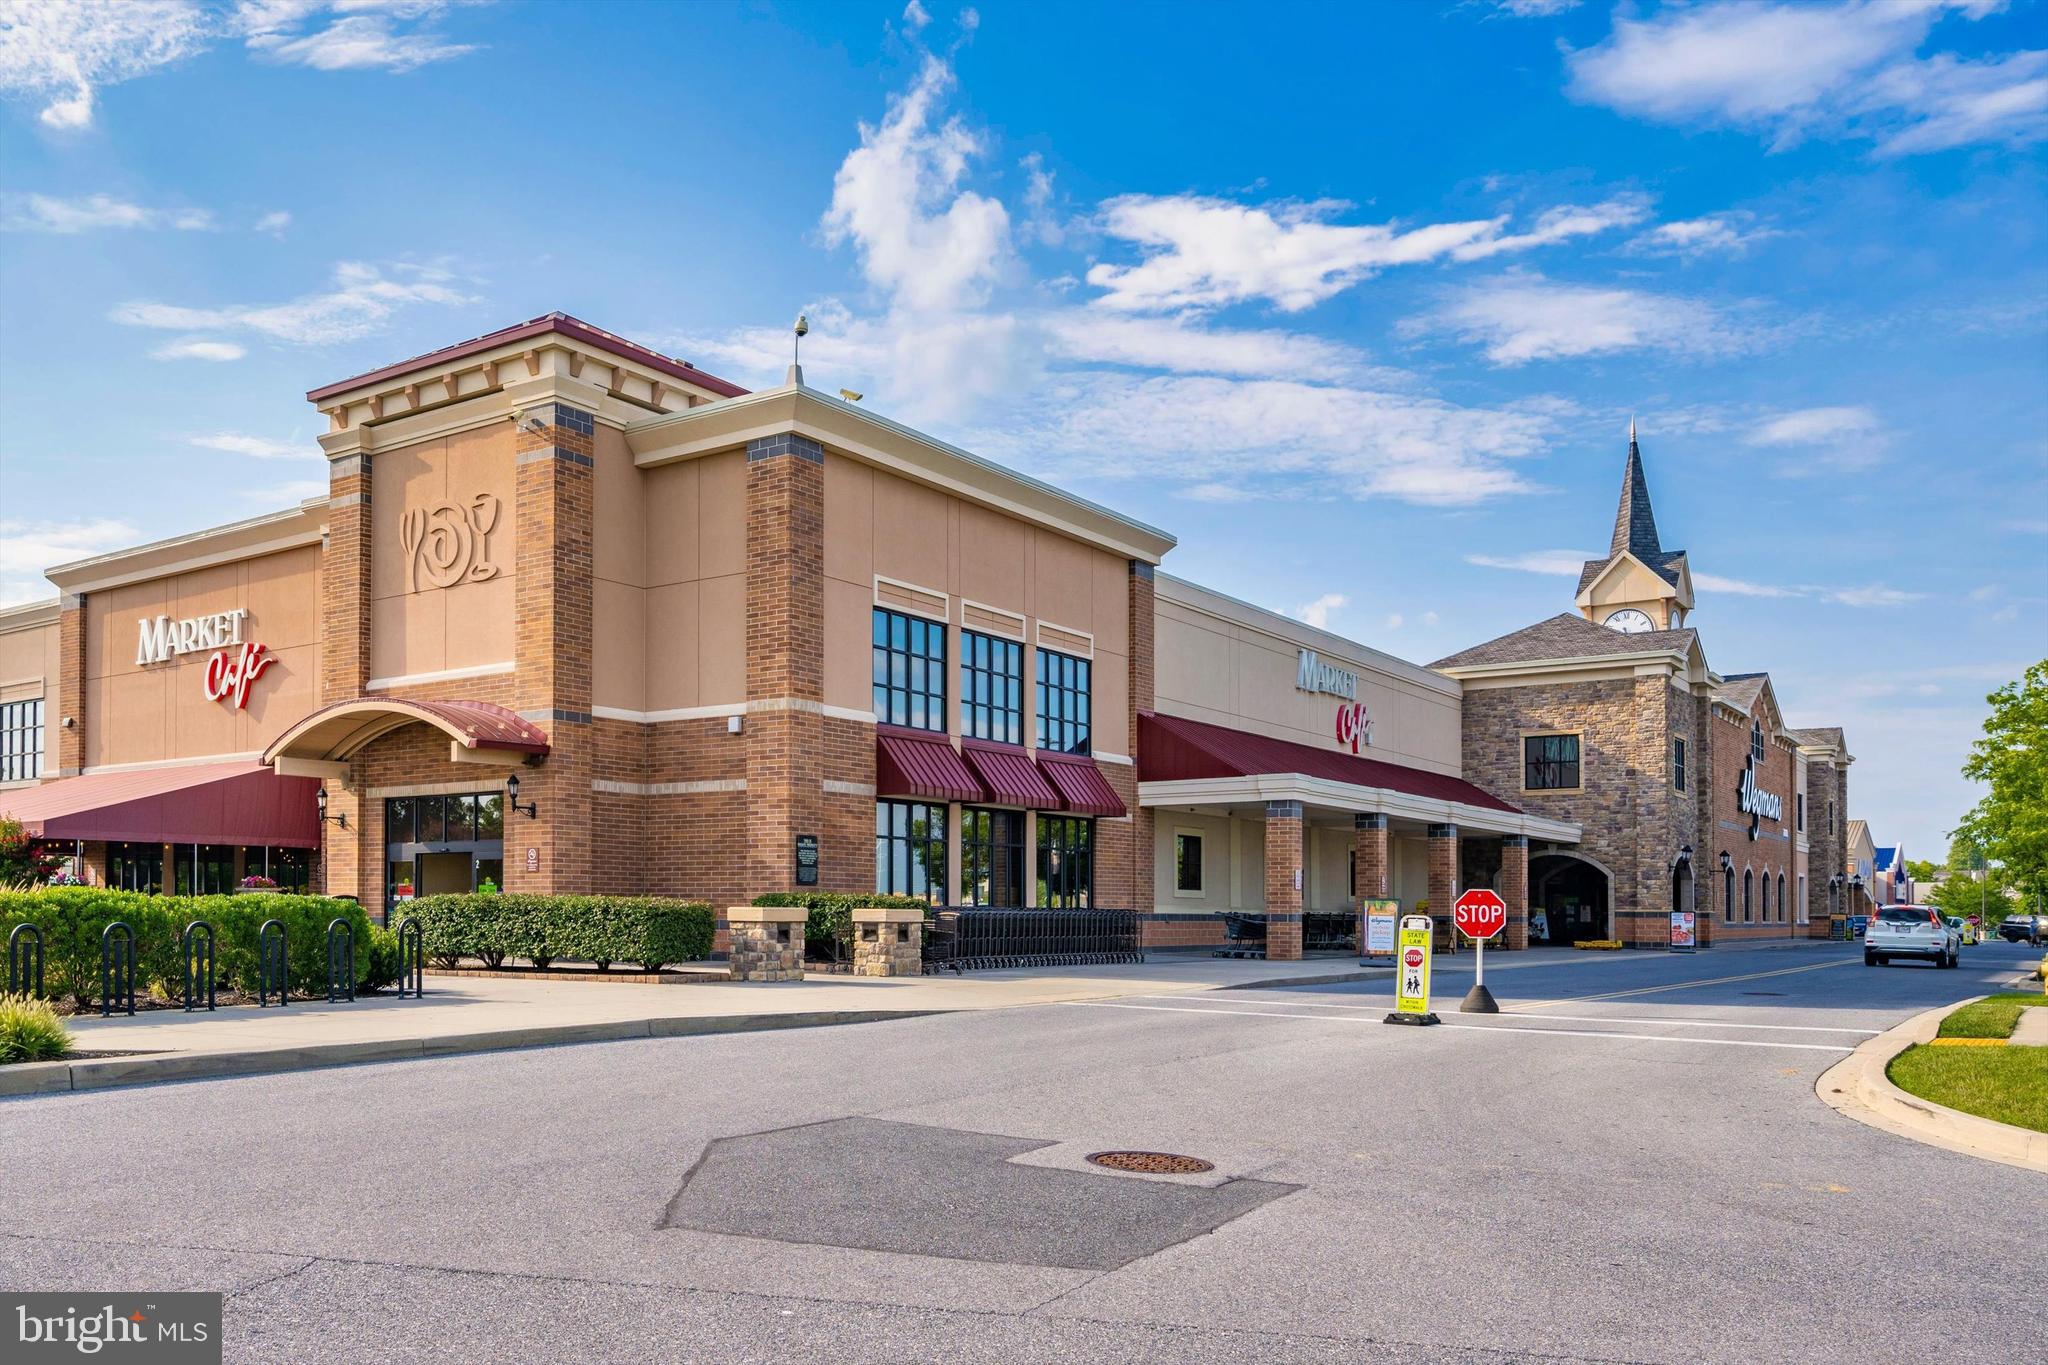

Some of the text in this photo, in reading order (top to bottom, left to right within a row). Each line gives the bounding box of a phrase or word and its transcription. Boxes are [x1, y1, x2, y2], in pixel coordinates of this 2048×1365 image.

[136, 608, 249, 665] MARKET
[204, 642, 277, 709] Café
[1296, 648, 1358, 701] MARKET
[1736, 753, 1783, 841] Wegmans
[1457, 905, 1502, 923] STOP
[1405, 954, 1423, 962] STOP
